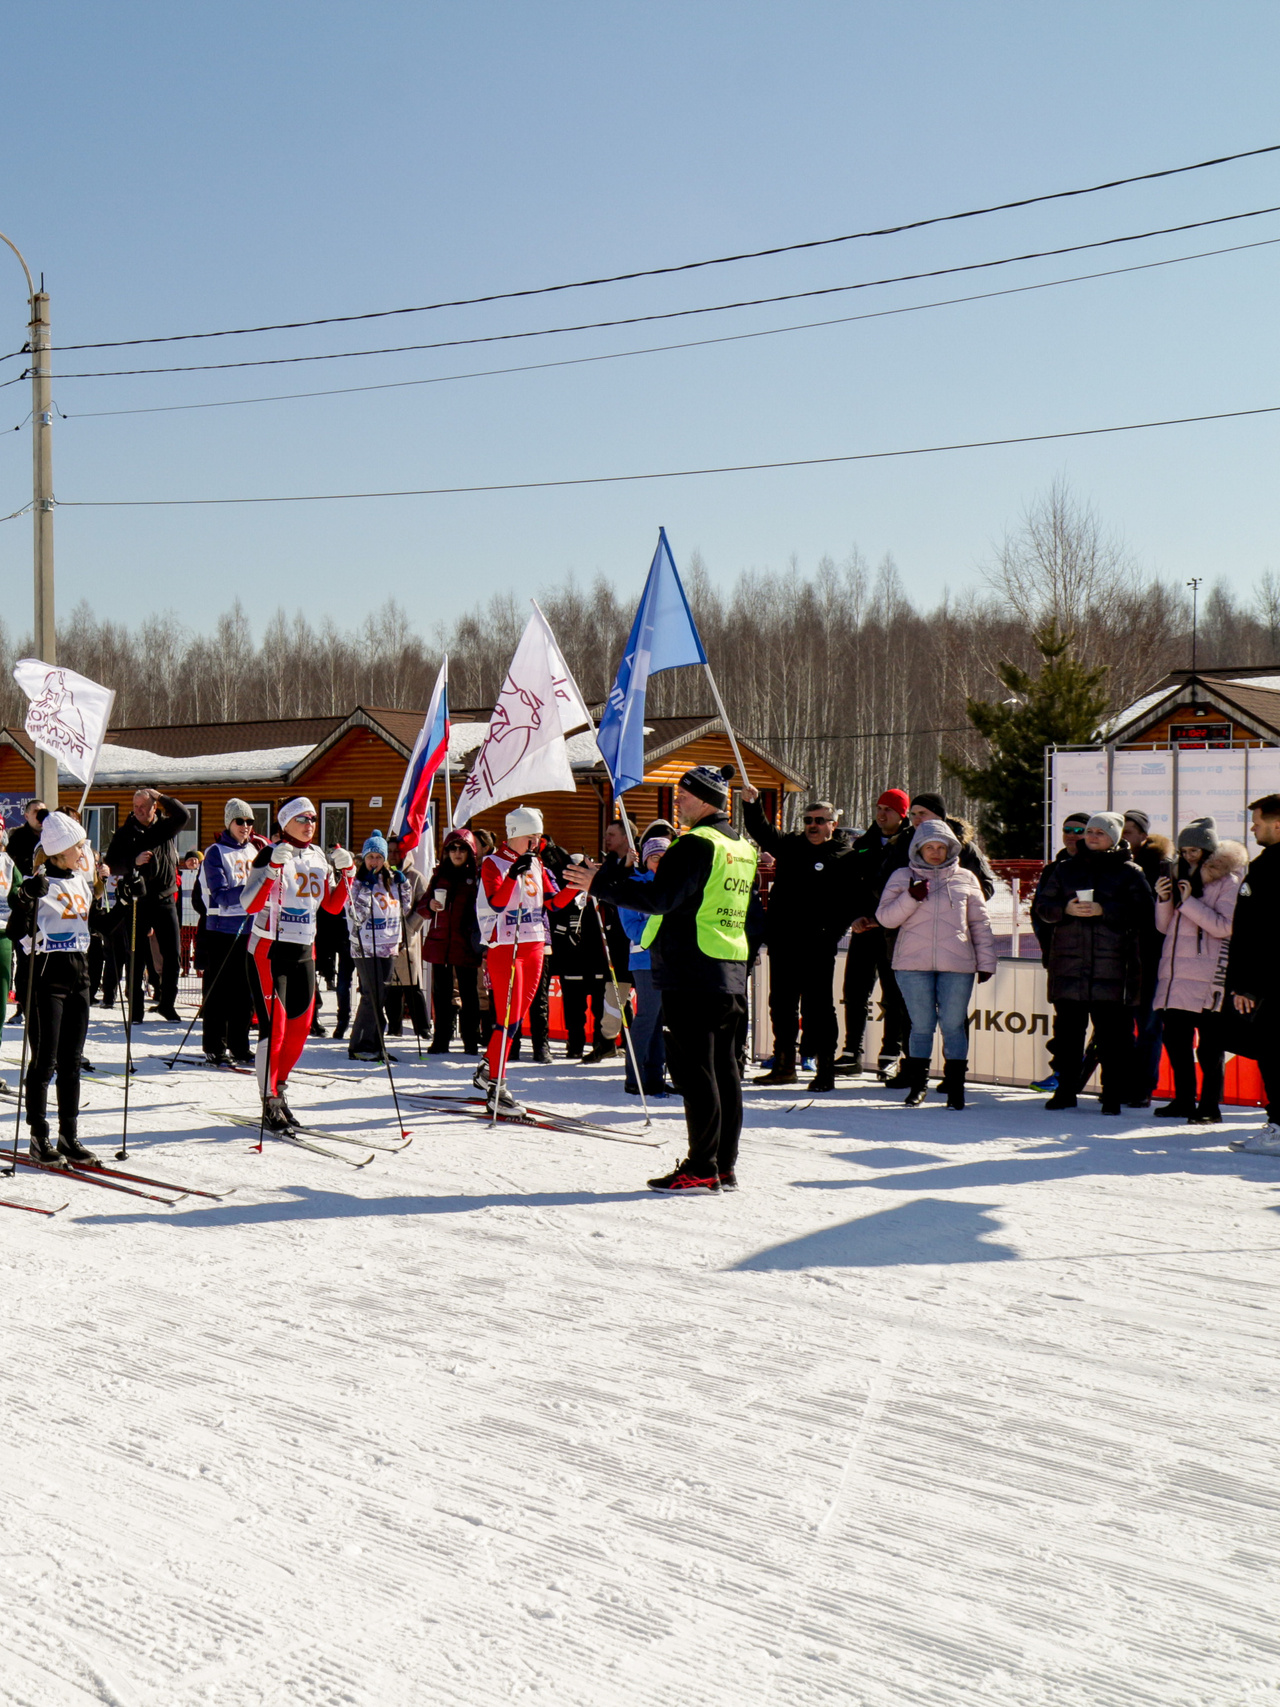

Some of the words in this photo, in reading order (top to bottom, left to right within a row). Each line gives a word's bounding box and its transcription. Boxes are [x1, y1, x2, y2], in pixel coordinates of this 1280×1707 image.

[294, 871, 321, 898] 26
[56, 892, 88, 921] 28
[281, 915, 309, 923] ИНВЕСТ
